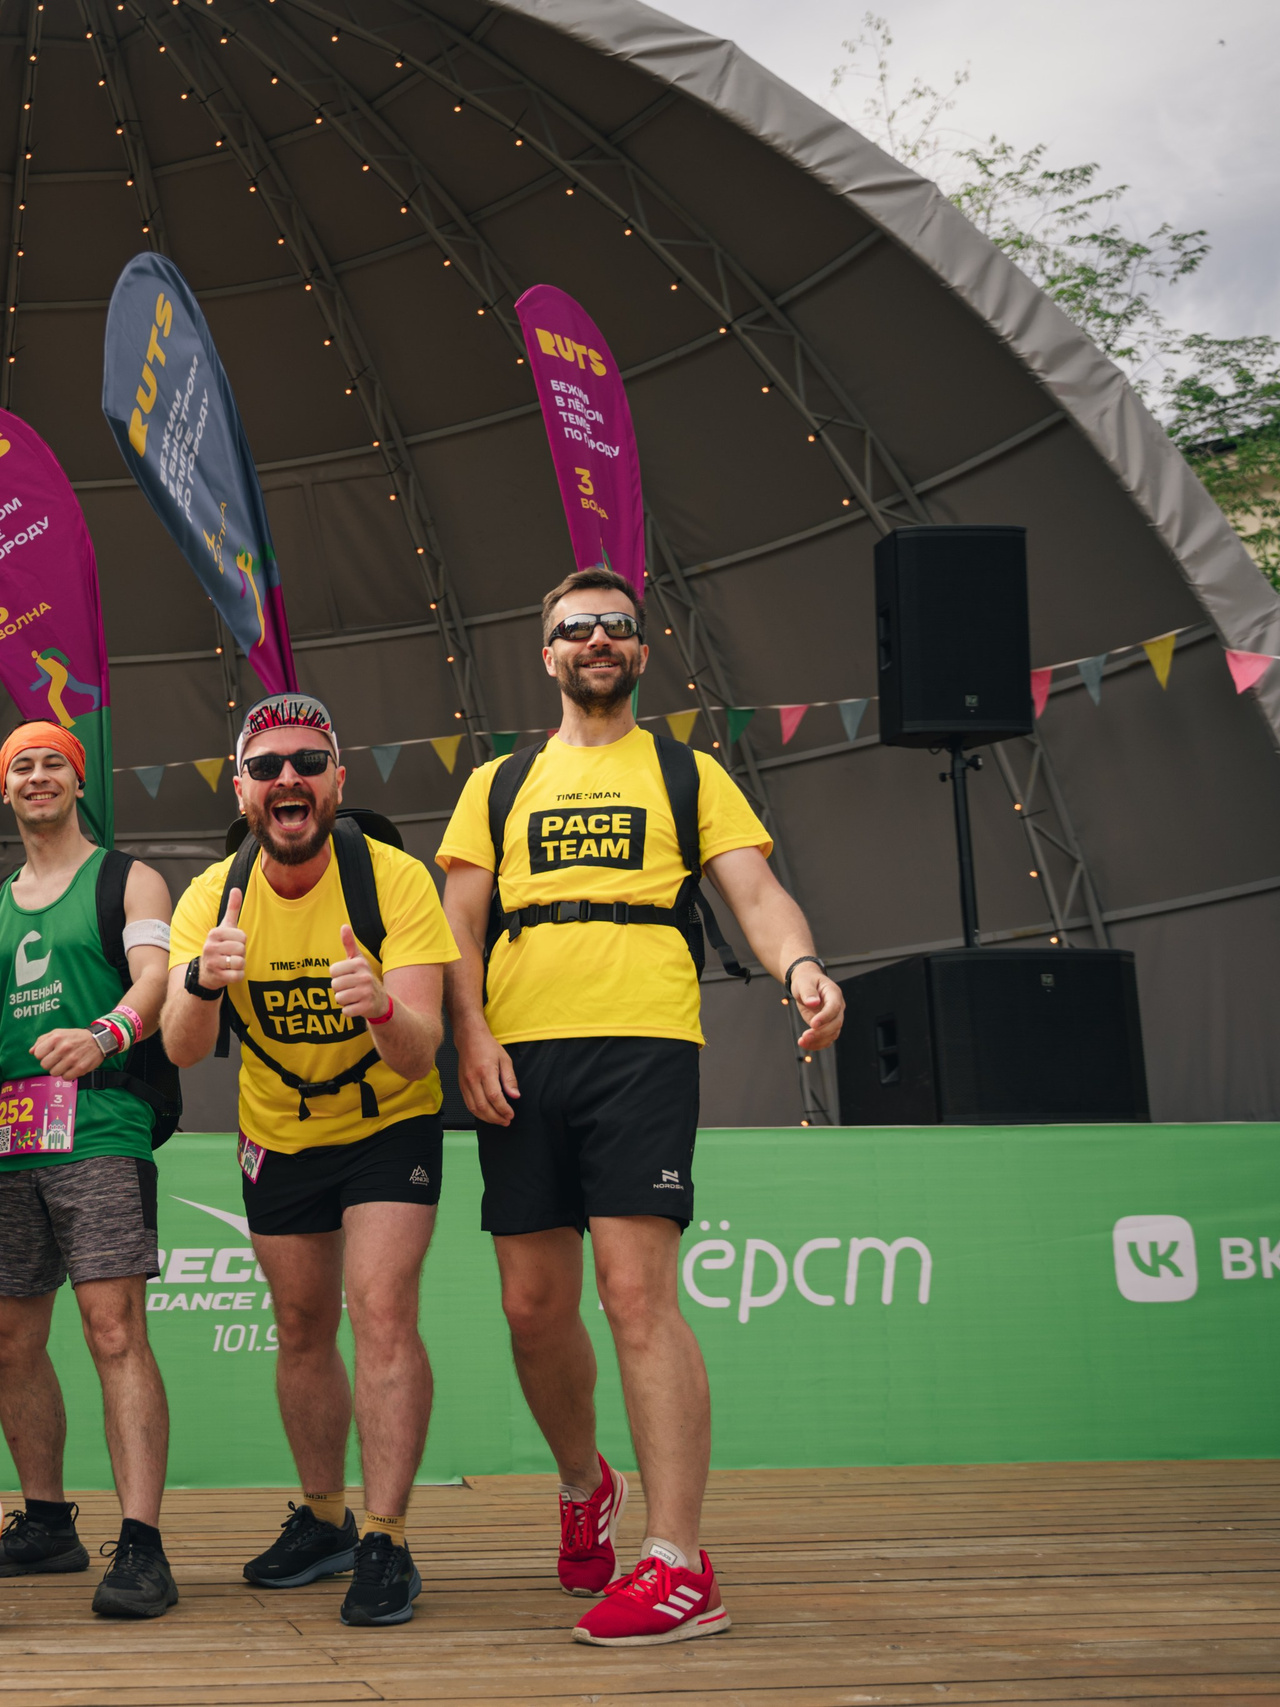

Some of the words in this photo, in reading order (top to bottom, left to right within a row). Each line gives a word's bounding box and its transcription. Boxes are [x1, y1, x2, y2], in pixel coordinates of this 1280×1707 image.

[535, 328, 607, 377] RUTS
[128, 292, 174, 458] RUTS
[555, 395, 566, 407] В
[169, 354, 199, 476] БЫСТРОМ
[160, 388, 182, 486] БЕЖИМ
[187, 388, 209, 486] ГОРОДУ
[564, 427, 583, 441] ПО
[176, 426, 194, 507] ТЕМПЕ
[574, 467, 595, 496] 3
[184, 489, 193, 524] ПО
[541, 813, 632, 837] PACE
[541, 838, 631, 862] TEAM
[9, 980, 63, 1005] ЗЕЛЕНЫЙ
[13, 998, 60, 1019] ФИТНЕС
[268, 1013, 354, 1036] TEAM
[53, 1094, 63, 1104] 3
[146, 1292, 256, 1311] DANCE
